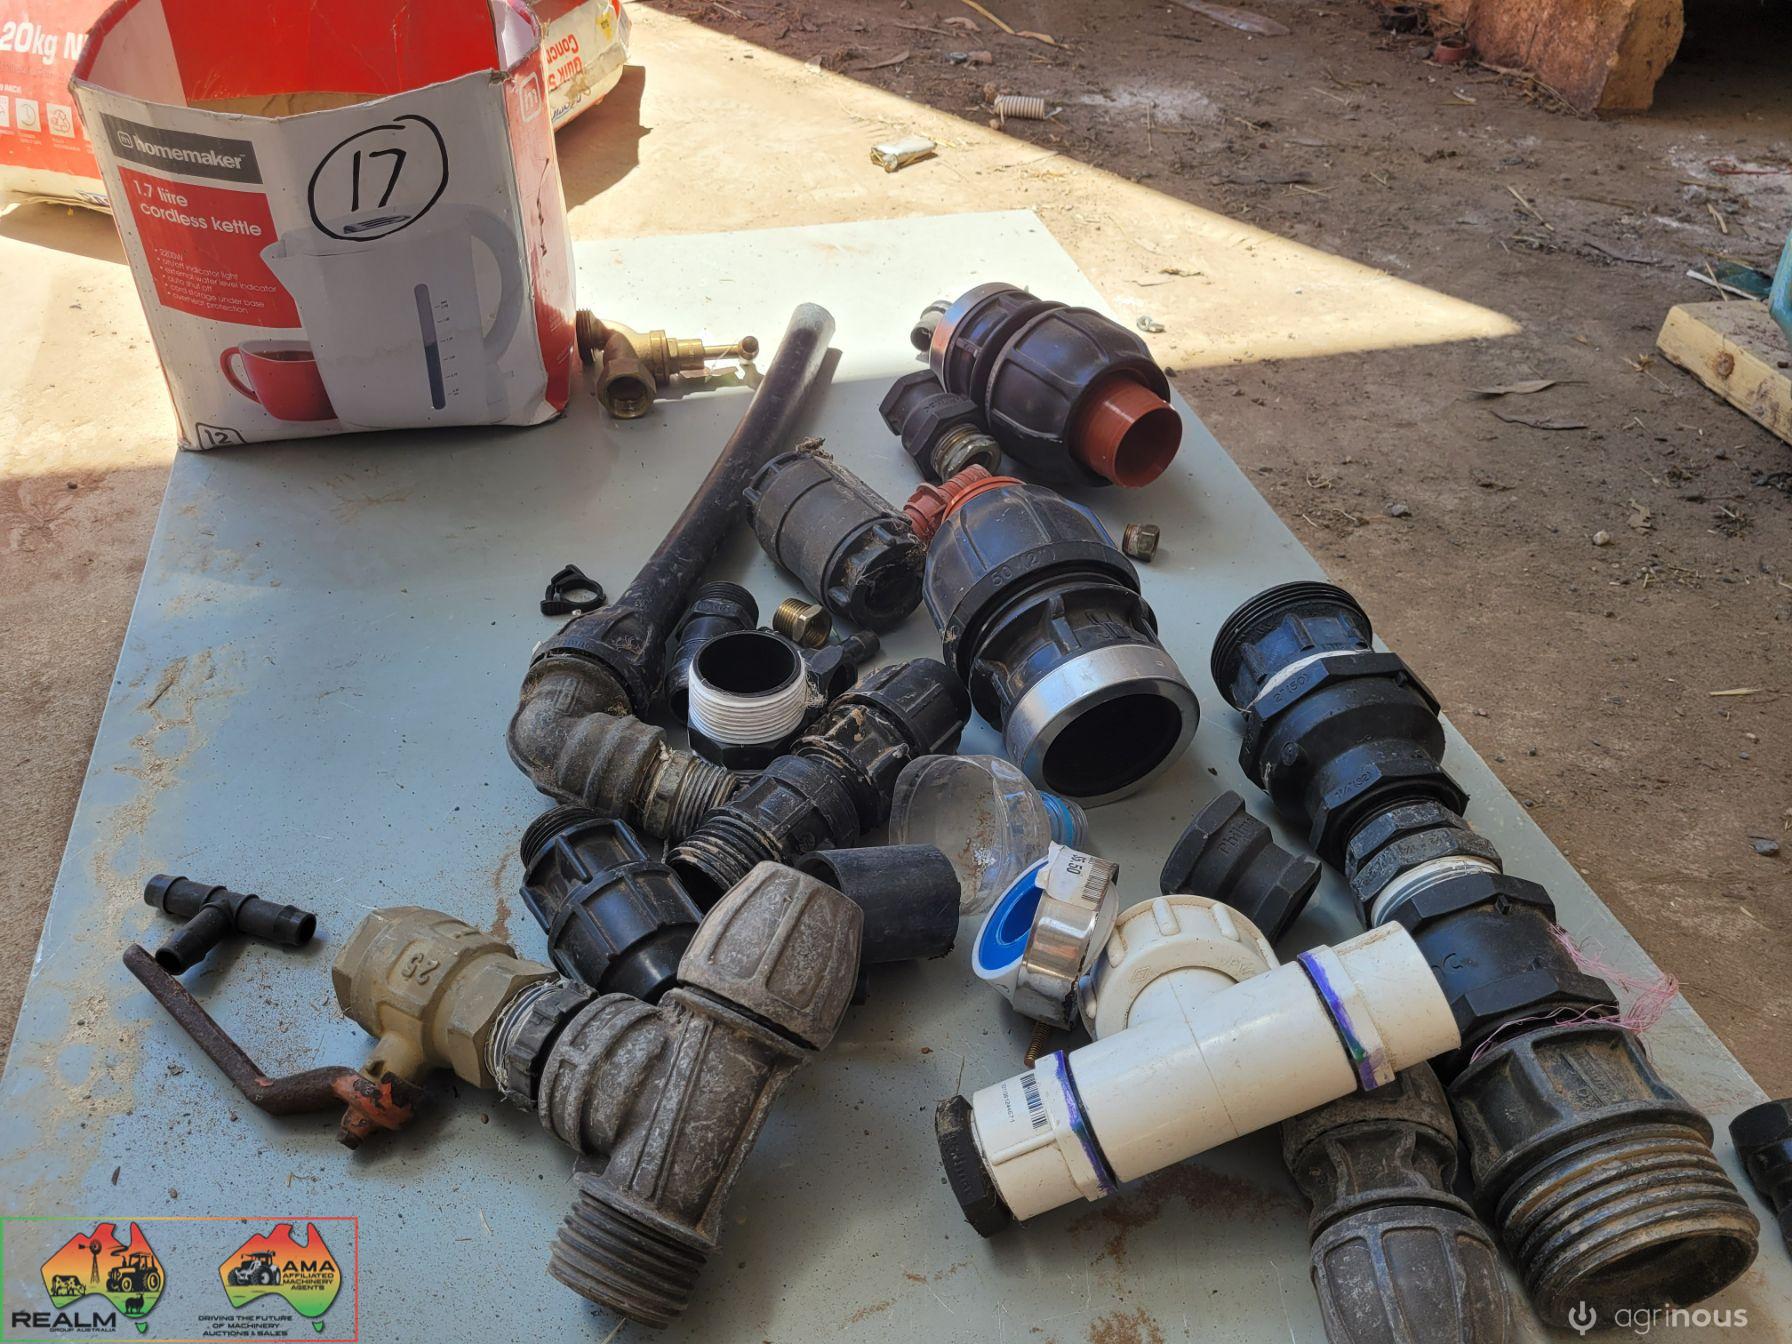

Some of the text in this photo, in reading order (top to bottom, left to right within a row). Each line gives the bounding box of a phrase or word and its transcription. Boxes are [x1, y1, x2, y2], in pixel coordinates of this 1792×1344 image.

[0, 21, 89, 65] 20kg N
[133, 133, 243, 169] homemaker
[133, 180, 152, 198] 1.7
[157, 186, 188, 207] litre
[351, 148, 407, 212] 17
[140, 203, 262, 237] cordless kettle
[205, 429, 233, 446] 12
